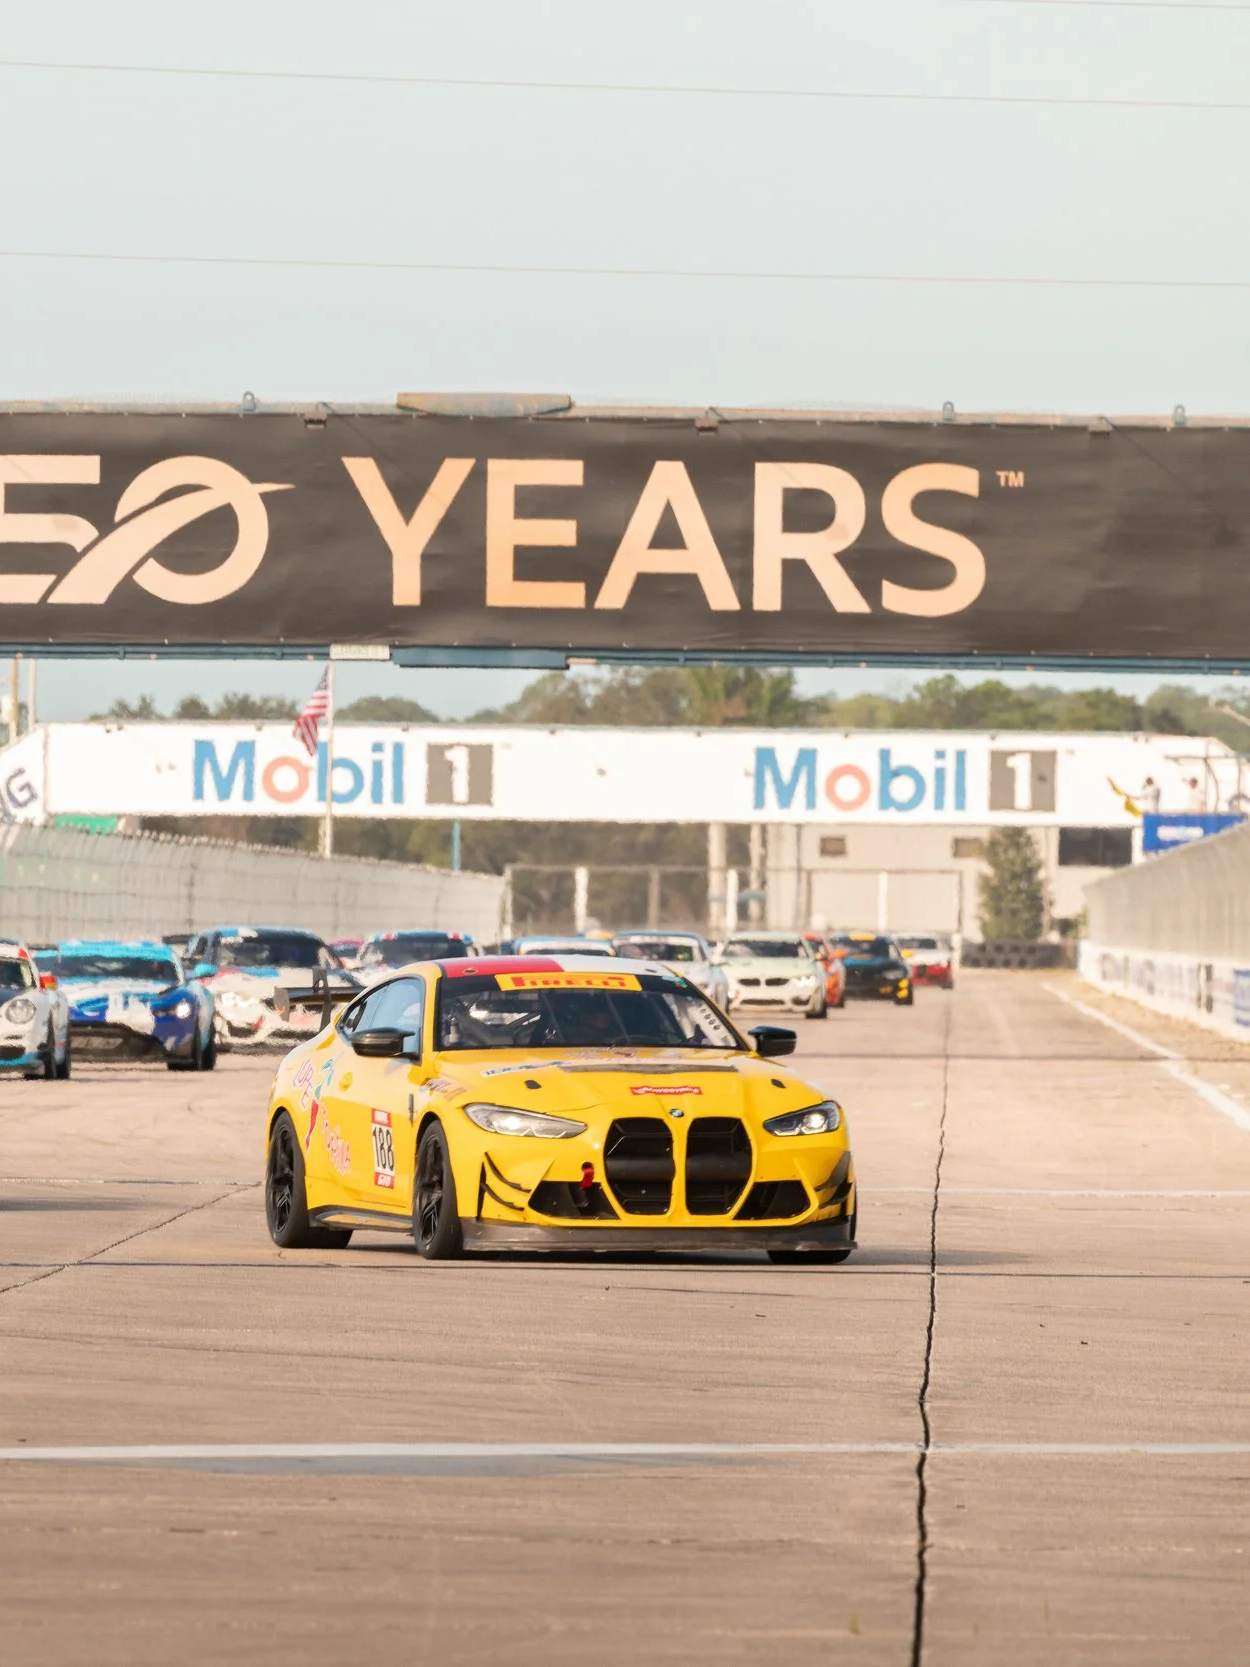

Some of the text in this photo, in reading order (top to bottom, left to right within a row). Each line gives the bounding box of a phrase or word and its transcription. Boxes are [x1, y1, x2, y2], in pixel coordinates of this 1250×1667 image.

[341, 456, 986, 617] YEARS
[193, 740, 404, 804] Mobil
[753, 746, 966, 812] Mobil
[510, 975, 627, 988] PIRELLI
[372, 1126, 395, 1173] 188
